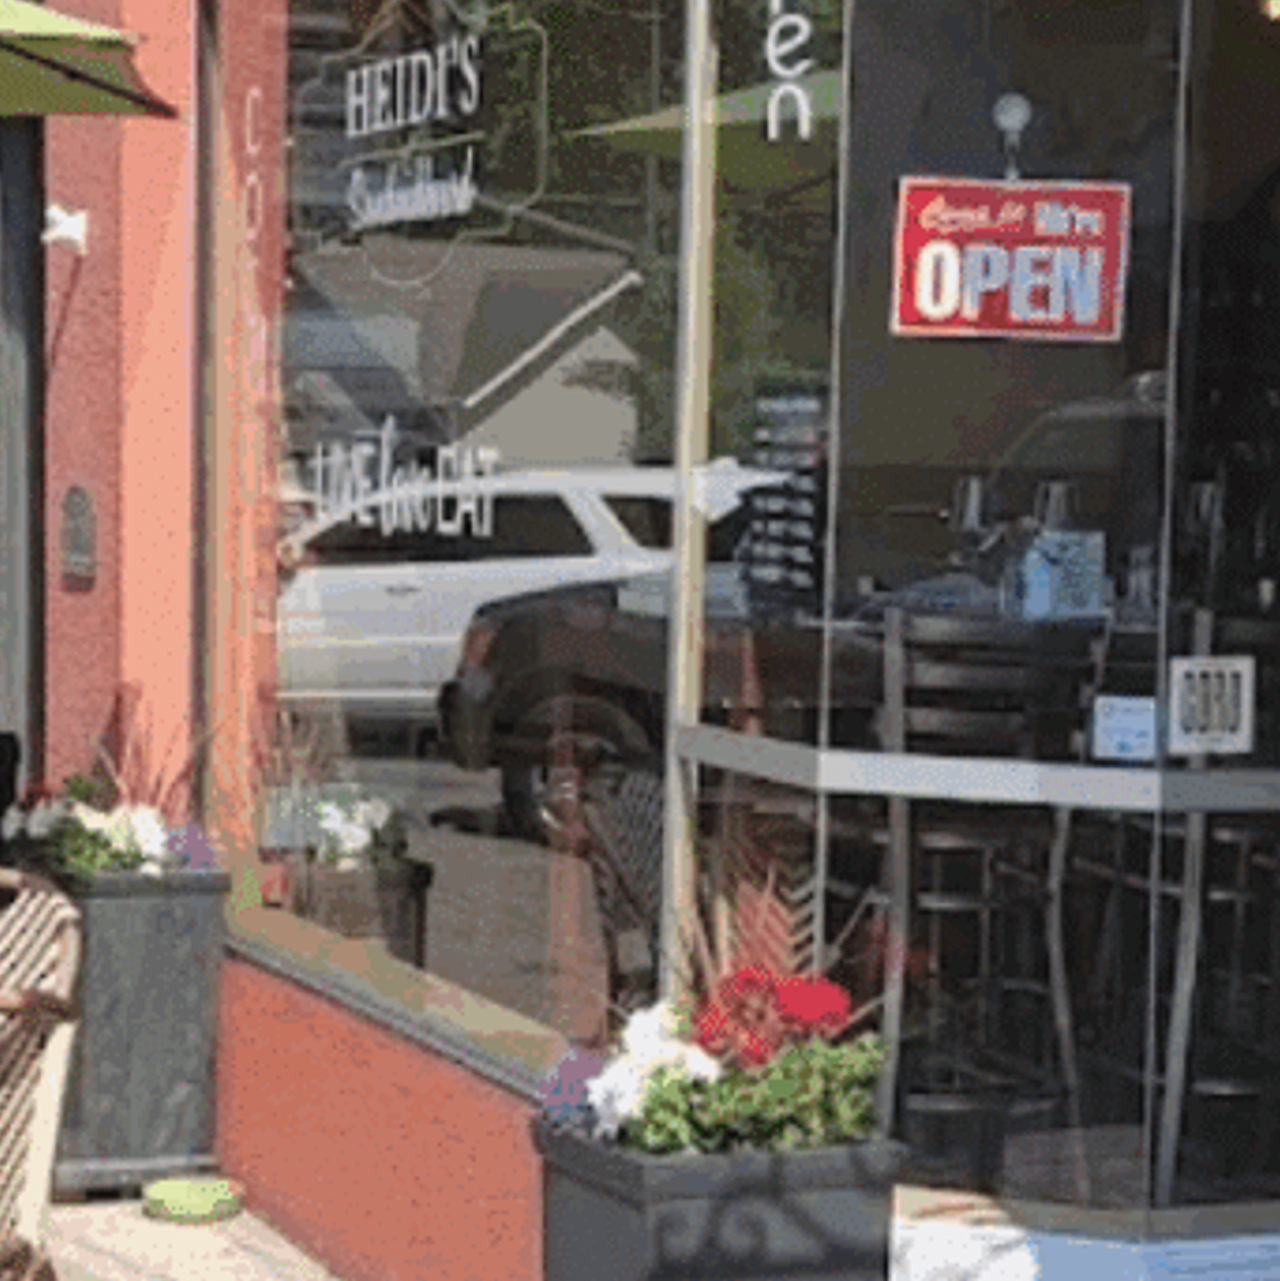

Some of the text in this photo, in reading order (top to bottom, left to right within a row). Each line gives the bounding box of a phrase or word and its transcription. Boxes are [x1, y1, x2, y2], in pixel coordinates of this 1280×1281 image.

[345, 34, 481, 138] HEIDI'S
[913, 239, 1105, 325] OPEN
[436, 442, 501, 537] EAT
